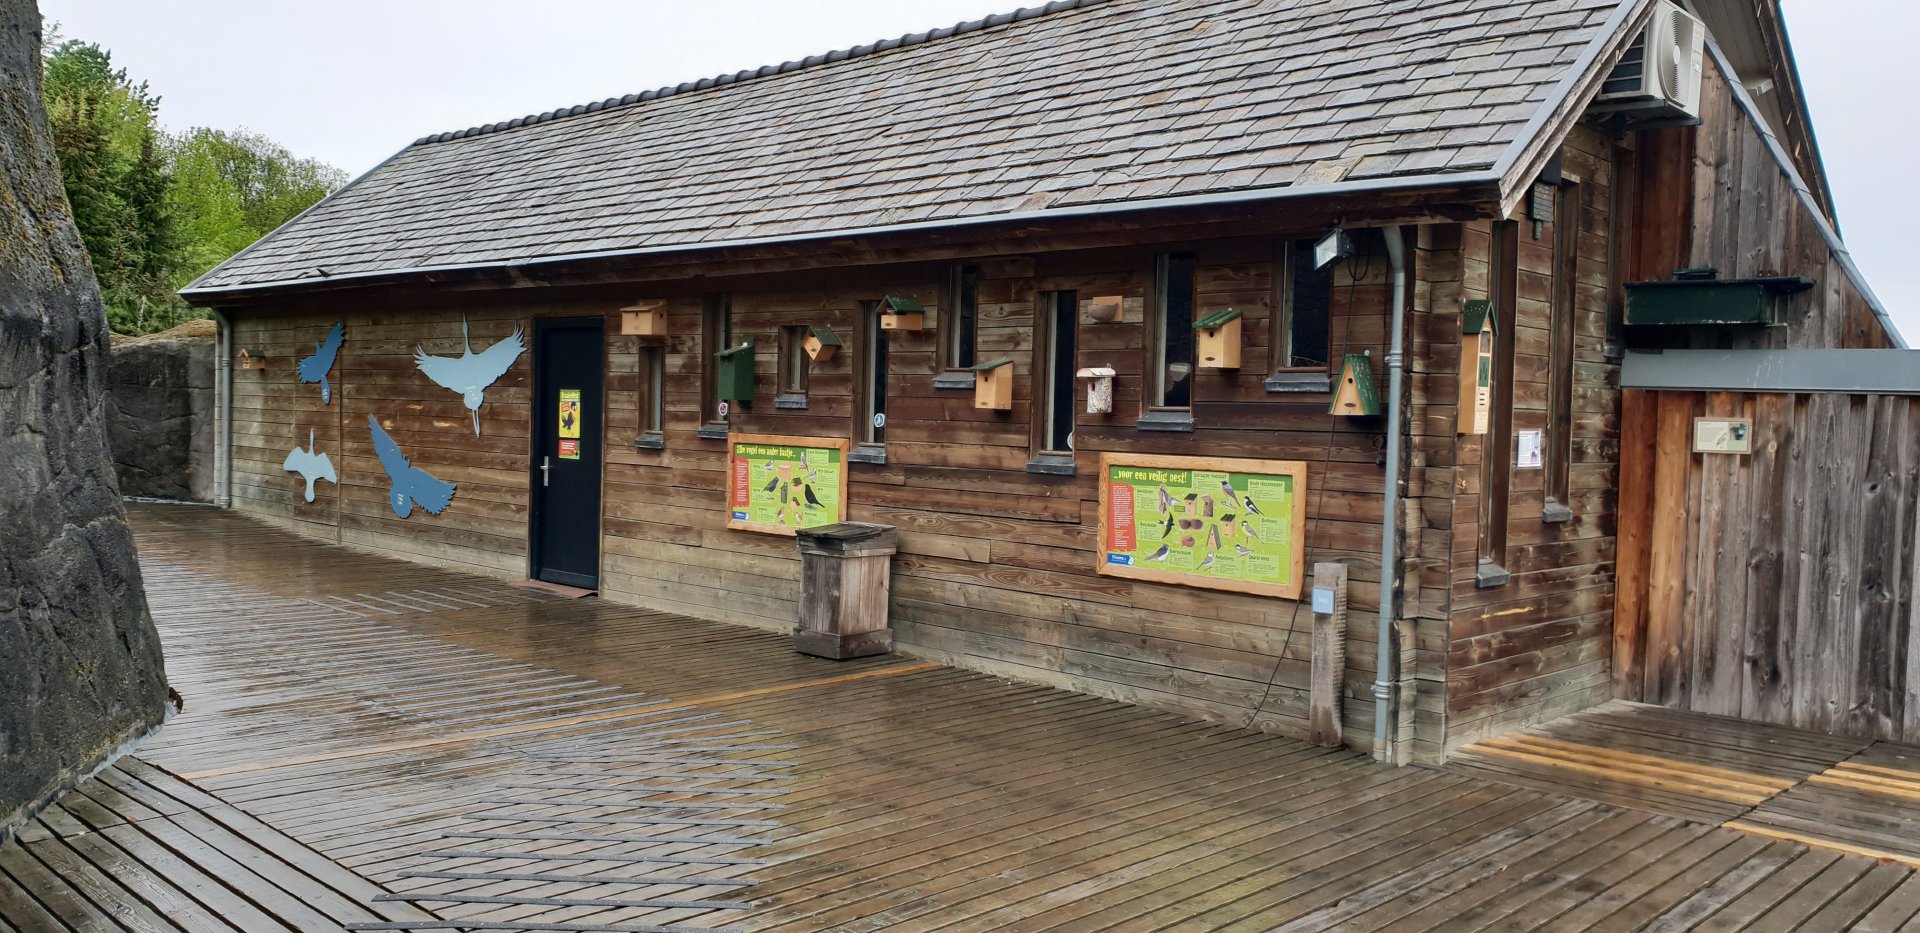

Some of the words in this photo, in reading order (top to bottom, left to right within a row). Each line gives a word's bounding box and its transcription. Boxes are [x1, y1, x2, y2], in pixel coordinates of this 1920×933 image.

[746, 446, 757, 455] vogel
[766, 448, 779, 456] ander
[1134, 471, 1147, 480] een
[1148, 471, 1168, 483] veilig
[1169, 472, 1187, 483] nest!
